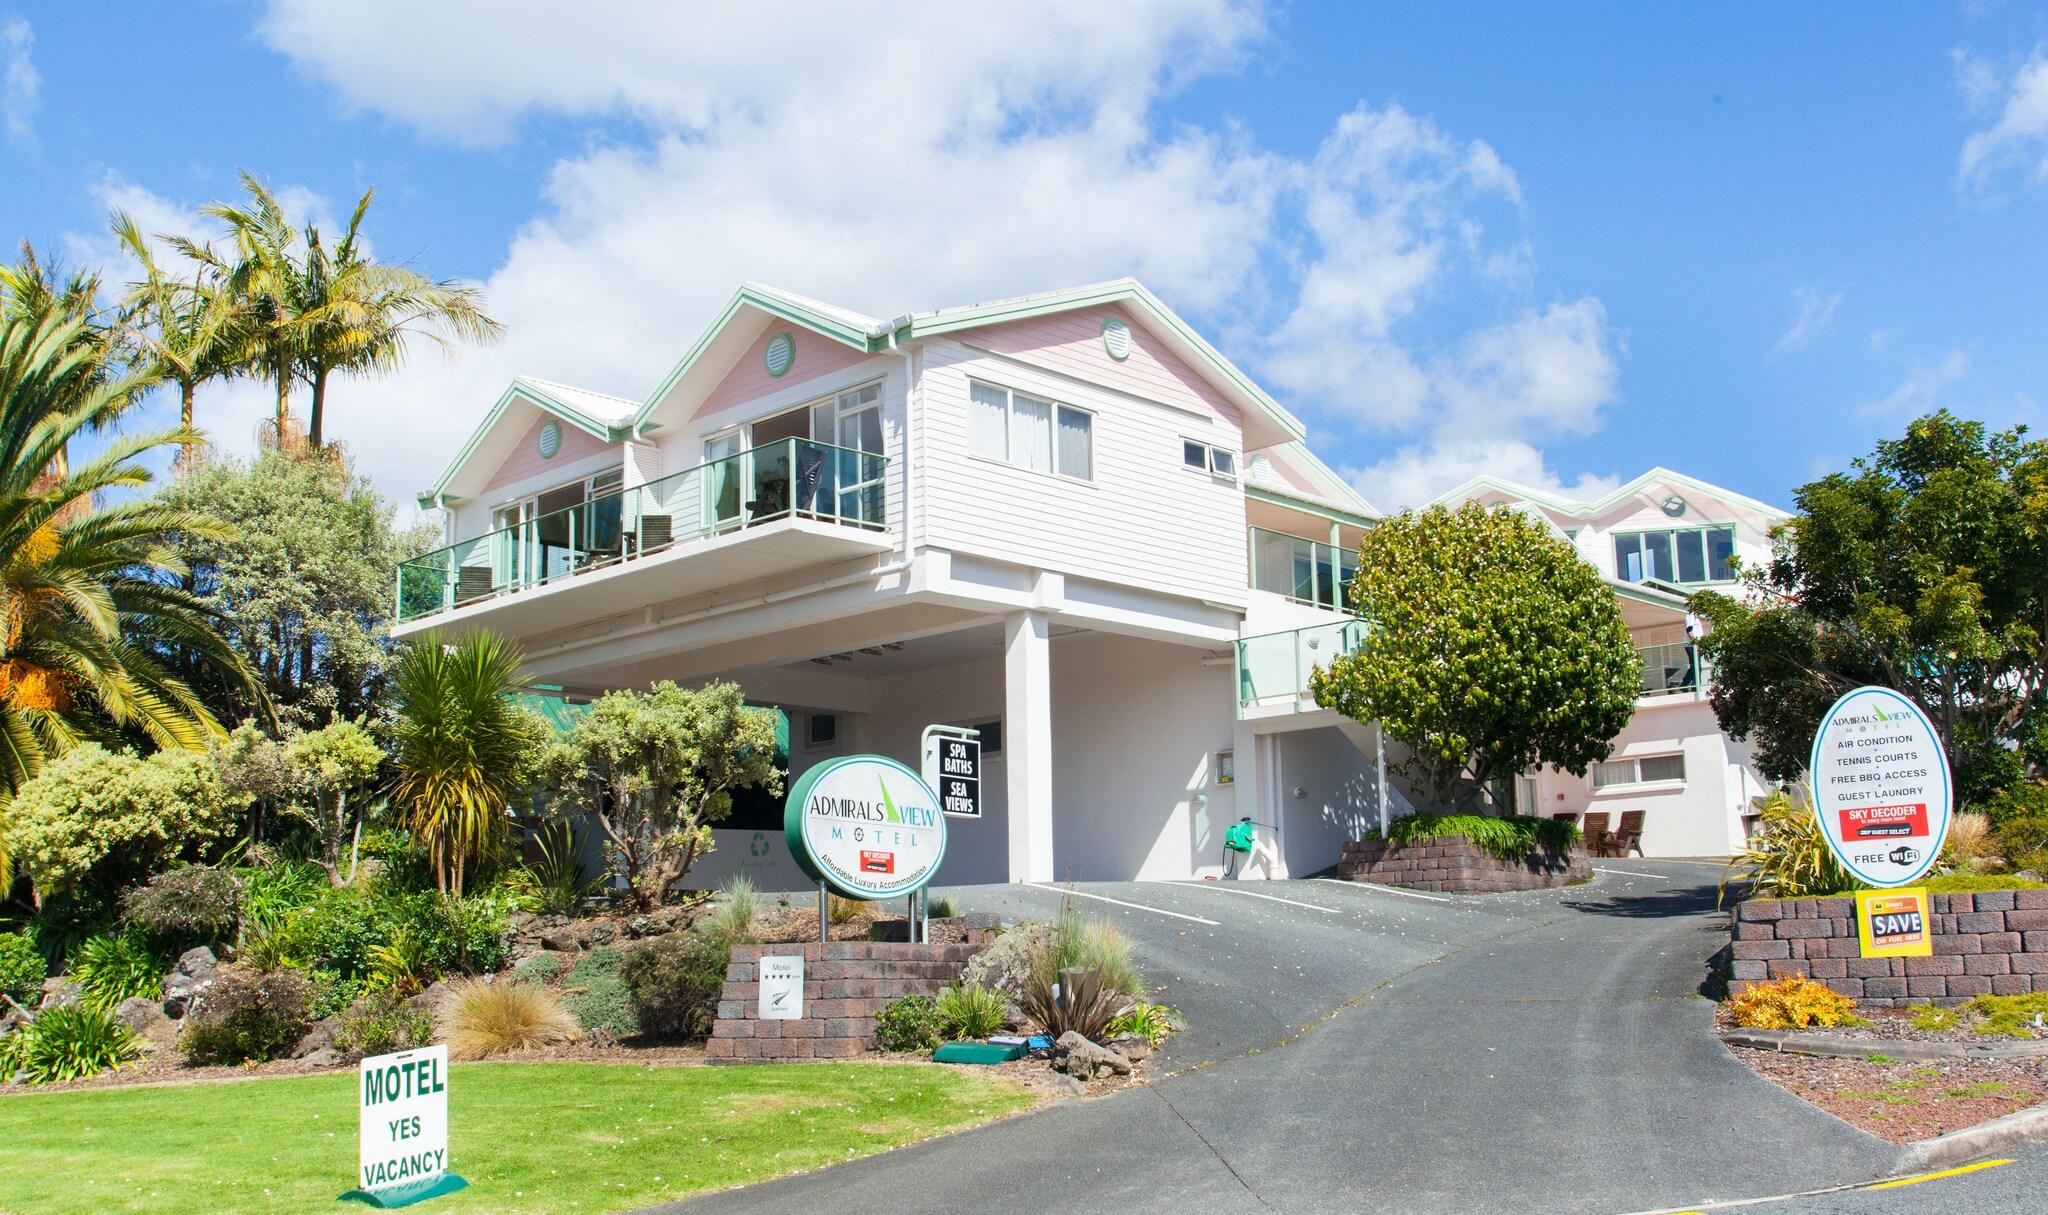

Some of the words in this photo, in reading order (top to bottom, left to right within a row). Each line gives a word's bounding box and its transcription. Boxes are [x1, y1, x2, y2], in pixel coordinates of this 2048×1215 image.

[1832, 714, 1878, 727] ADMIRALS
[1887, 711, 1912, 721] VIEW
[1837, 740, 1854, 749] AIR
[1857, 735, 1913, 747] CONDITION
[950, 743, 966, 759] SPA
[1837, 756, 1872, 766] TENNIS
[1875, 751, 1918, 763] COURTS
[944, 757, 973, 775] BATHS
[1831, 775, 1856, 784] FREE
[1859, 773, 1881, 782] BBQ
[1885, 768, 1927, 780] ACCESS
[950, 781, 967, 797] SEA
[1838, 791, 1871, 801] GUEST
[1875, 786, 1924, 798] LAUNDRY
[810, 795, 885, 822] ADMIRALS
[899, 806, 936, 828] VIEW
[945, 796, 974, 813] VIEWS
[1848, 809, 1869, 820] SKY
[1871, 805, 1917, 818] DECODER
[1854, 854, 1885, 864] FREE
[821, 853, 854, 882] Affordable
[854, 877, 878, 891] Luxury
[879, 865, 927, 889] Accommodation
[1875, 913, 1921, 935] SAVE
[1875, 937, 1887, 945] ON
[365, 1058, 444, 1106] MOTEL
[388, 1115, 421, 1142] YES
[364, 1148, 445, 1187] VACANCY
